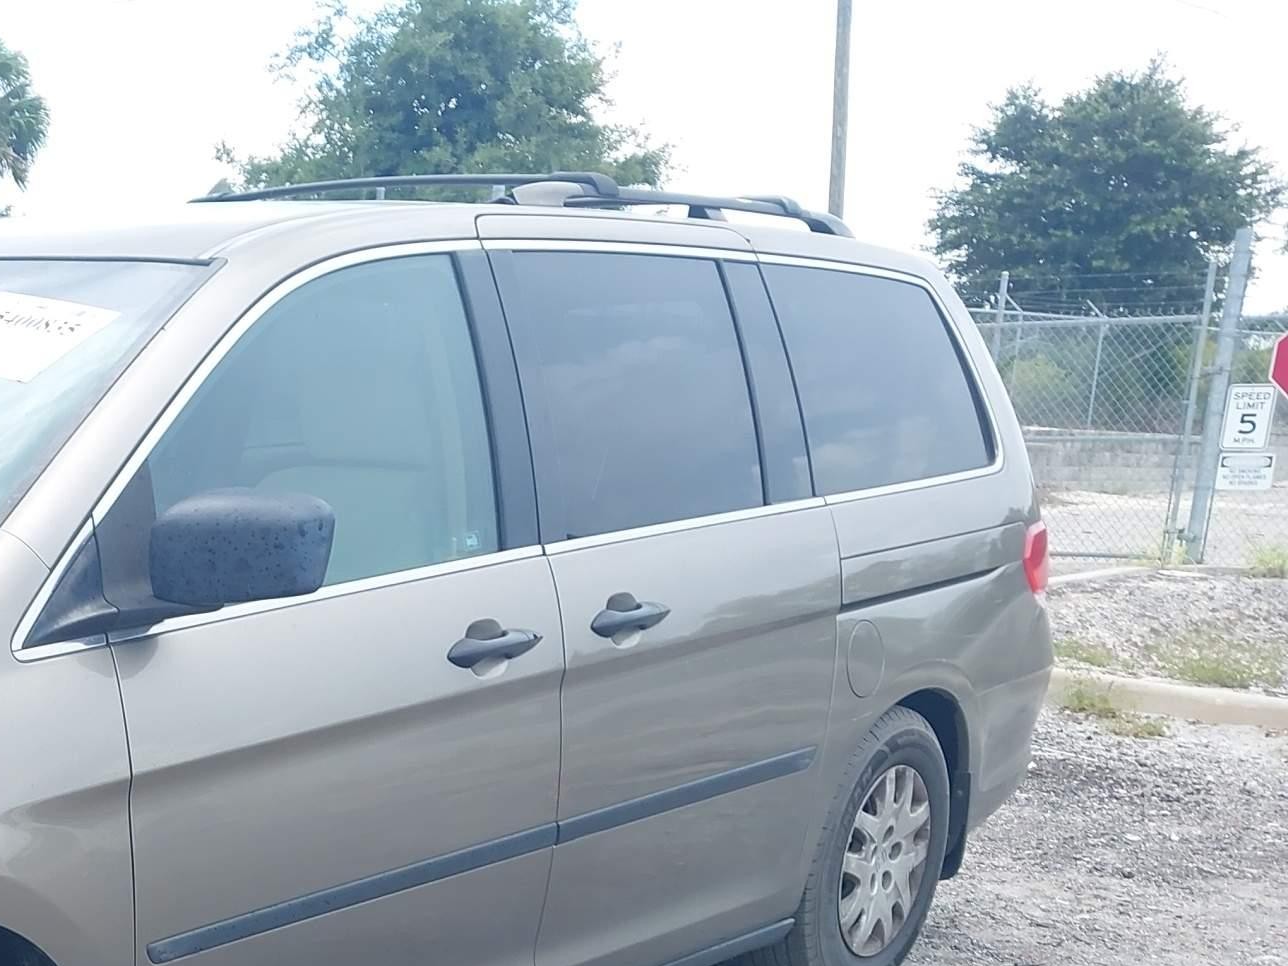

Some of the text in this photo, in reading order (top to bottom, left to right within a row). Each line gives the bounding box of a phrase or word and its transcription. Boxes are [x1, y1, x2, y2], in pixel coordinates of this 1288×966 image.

[1233, 391, 1272, 400] SPEED
[1236, 402, 1266, 410] LIMIT
[1238, 413, 1257, 434] 5
